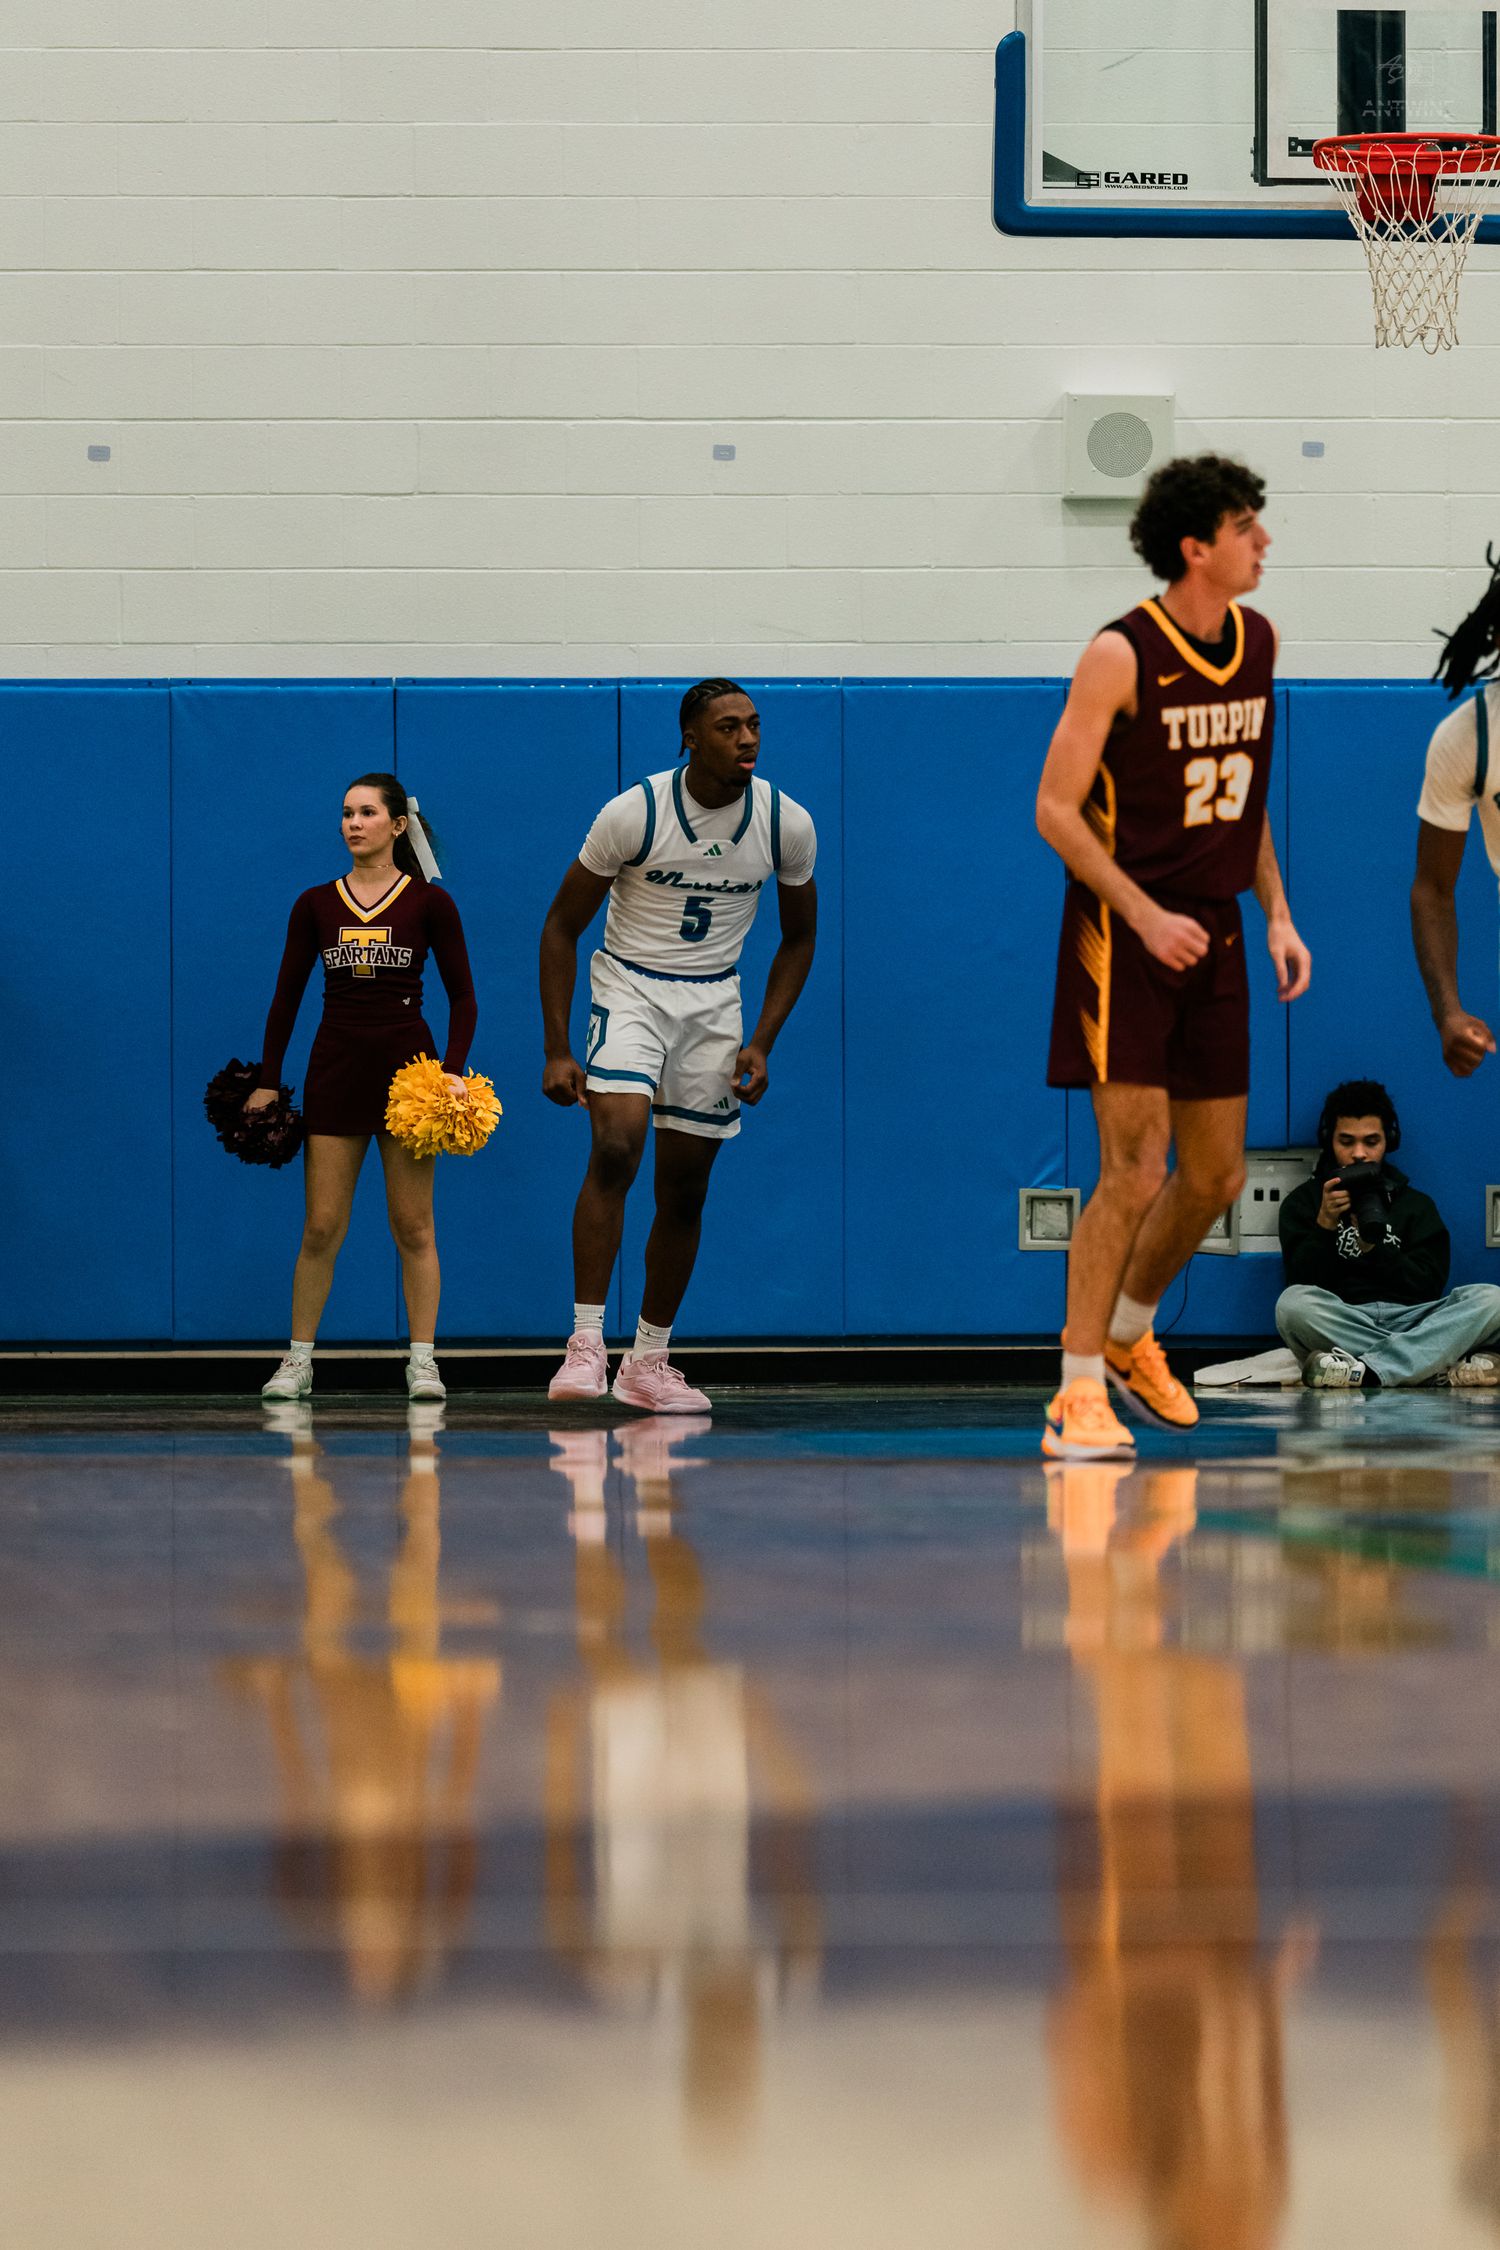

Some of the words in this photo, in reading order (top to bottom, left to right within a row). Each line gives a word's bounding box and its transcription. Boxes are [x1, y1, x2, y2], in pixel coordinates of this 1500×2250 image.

[1104, 171, 1188, 185] GARED
[1161, 697, 1267, 750] TURPIN
[1184, 753, 1254, 828] 23
[679, 896, 715, 942] 5
[323, 945, 412, 969] SPARTANS
